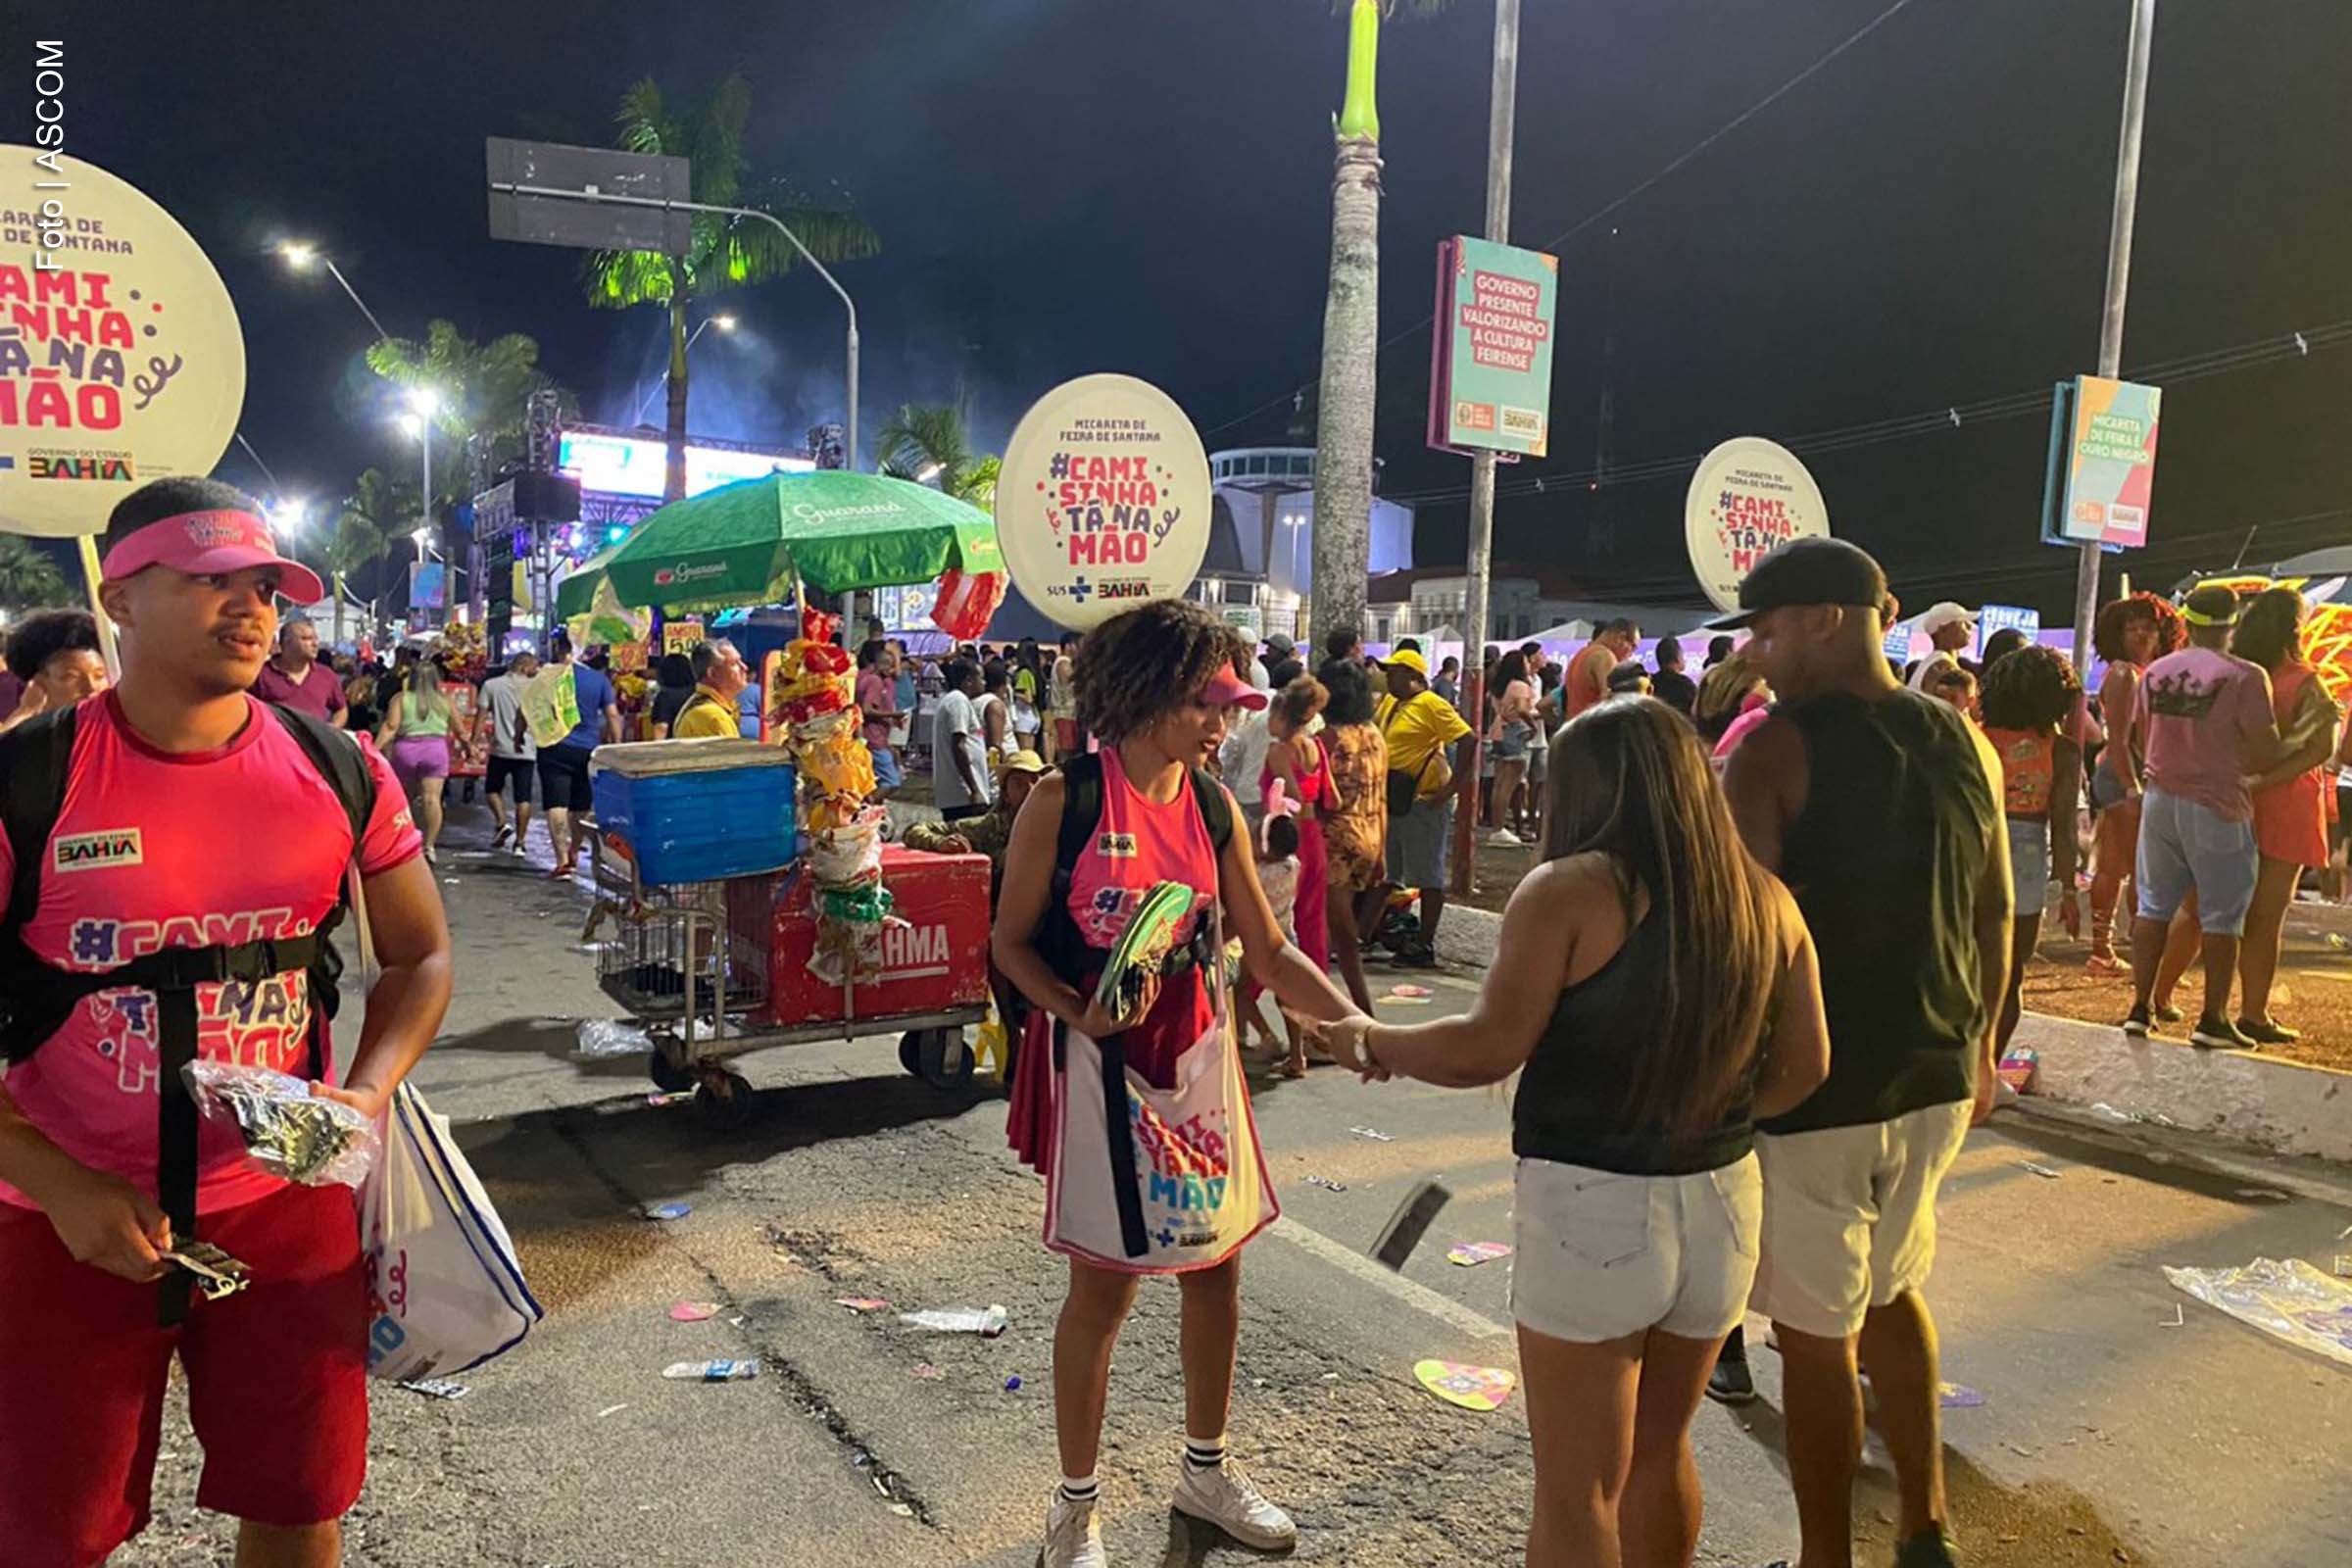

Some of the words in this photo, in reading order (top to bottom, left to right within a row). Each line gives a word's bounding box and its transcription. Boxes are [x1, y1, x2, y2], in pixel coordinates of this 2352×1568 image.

[5, 228, 31, 245] DE
[77, 219, 104, 234] DE
[1476, 274, 1538, 299] GOVERNO
[1478, 294, 1535, 317] PRESENTE
[0, 304, 133, 349] NHA
[1462, 307, 1545, 336] VALORIZANDO
[1473, 328, 1483, 342] A
[1484, 331, 1534, 353] CULTURA
[49, 337, 125, 388] NA
[1477, 347, 1529, 368] FEIRENSE
[1074, 418, 1131, 429] MICARETA
[1133, 419, 1146, 429] DE
[1059, 431, 1094, 441] FEIRA
[1097, 431, 1110, 441] DE
[1112, 431, 1160, 442] SANTANA
[29, 457, 132, 482] BAHIA
[1050, 452, 1148, 481] #CAMI
[1059, 482, 1156, 507] SINHA
[1720, 491, 1786, 518] #CAMI
[793, 501, 906, 525] Guaraná
[1113, 504, 1152, 533] NA
[1726, 513, 1791, 537] SINHA
[1069, 524, 1148, 565] MÃO
[675, 561, 728, 581] Guaraná
[1733, 545, 1767, 572] MÃ
[1047, 585, 1067, 596] SUS
[1099, 583, 1150, 599] BAHIA
[1984, 607, 2036, 628] CERVEJA
[59, 838, 137, 864] BAHIA
[880, 924, 951, 966] HMA
